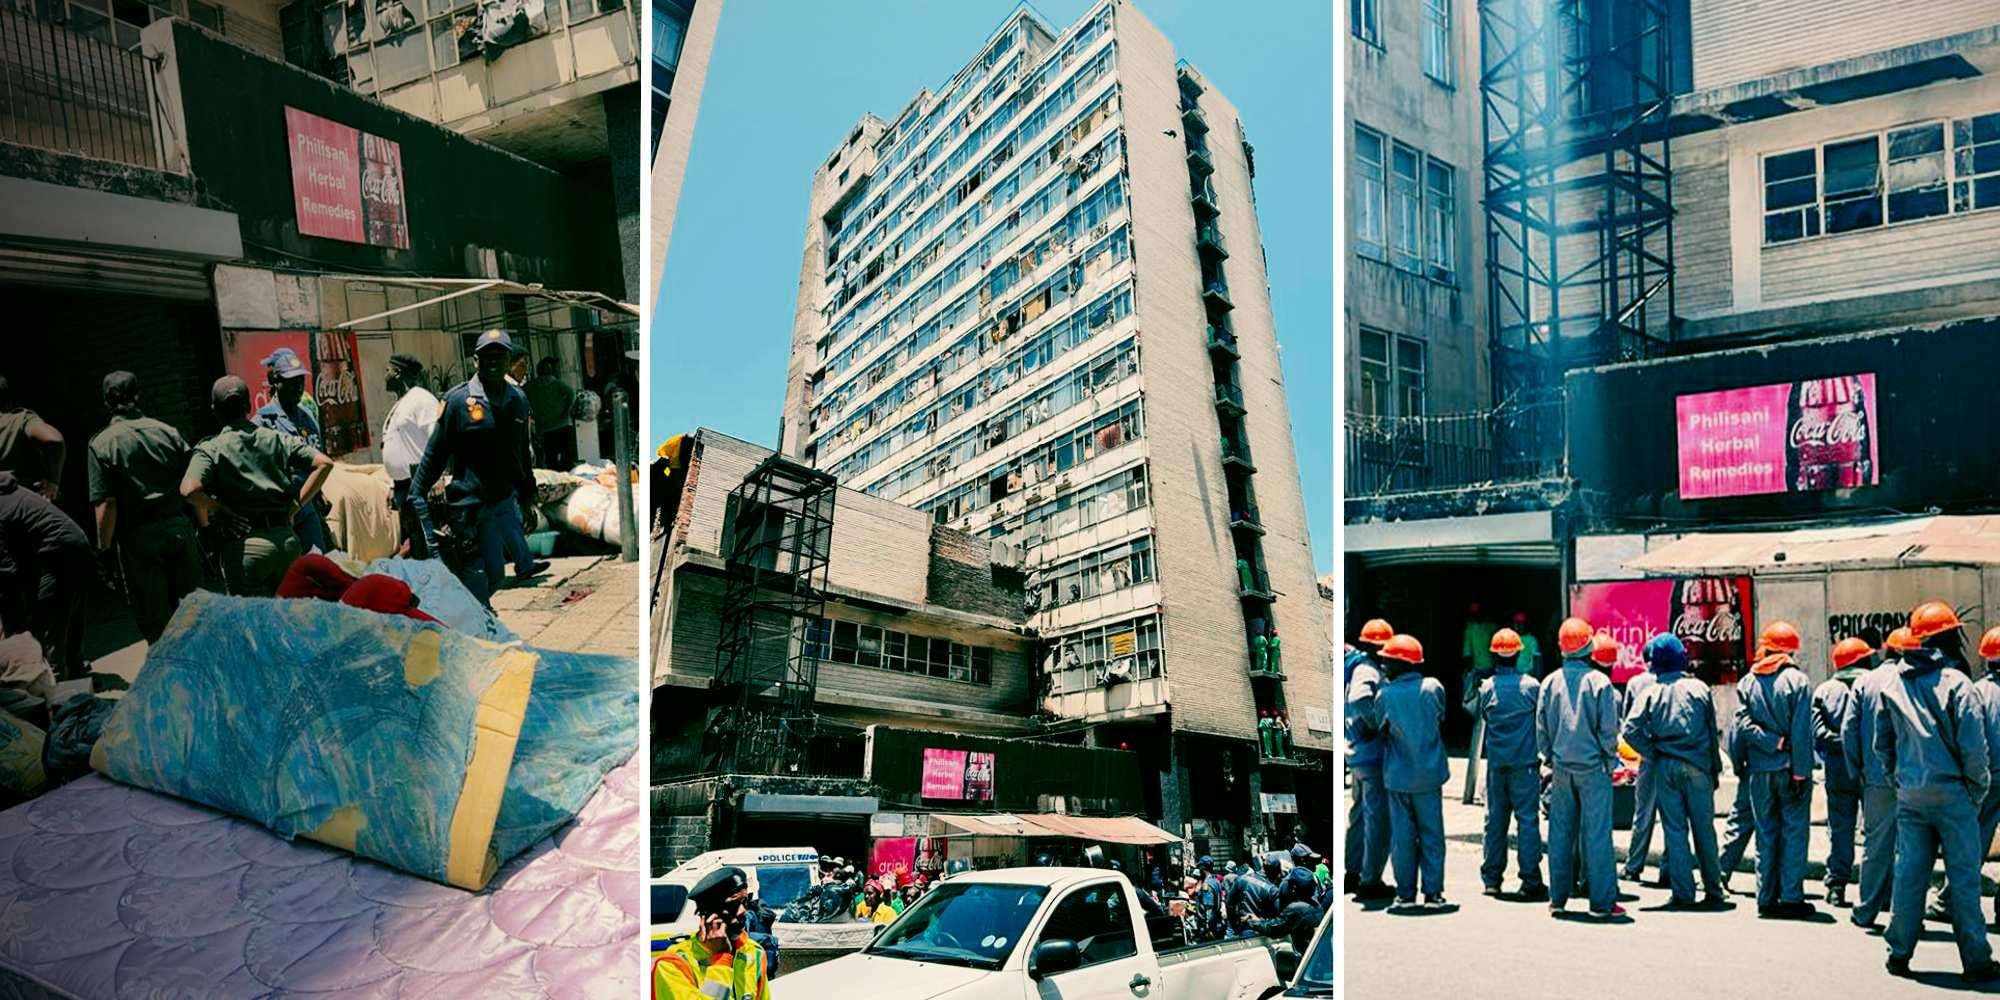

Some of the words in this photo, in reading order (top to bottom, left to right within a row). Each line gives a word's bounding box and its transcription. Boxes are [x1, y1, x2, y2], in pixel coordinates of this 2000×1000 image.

[297, 133, 349, 162] Philisani
[308, 166, 346, 190] Herbal
[302, 196, 357, 220] Remedies
[1689, 406, 1769, 431] Philisani
[1790, 410, 1865, 448] Coca-Cola
[1702, 435, 1760, 453] Herbal
[1690, 463, 1773, 480] Remedies
[1673, 612, 1742, 642] Coca-Cola
[762, 854, 797, 862] POLICE
[878, 856, 909, 872] drink
